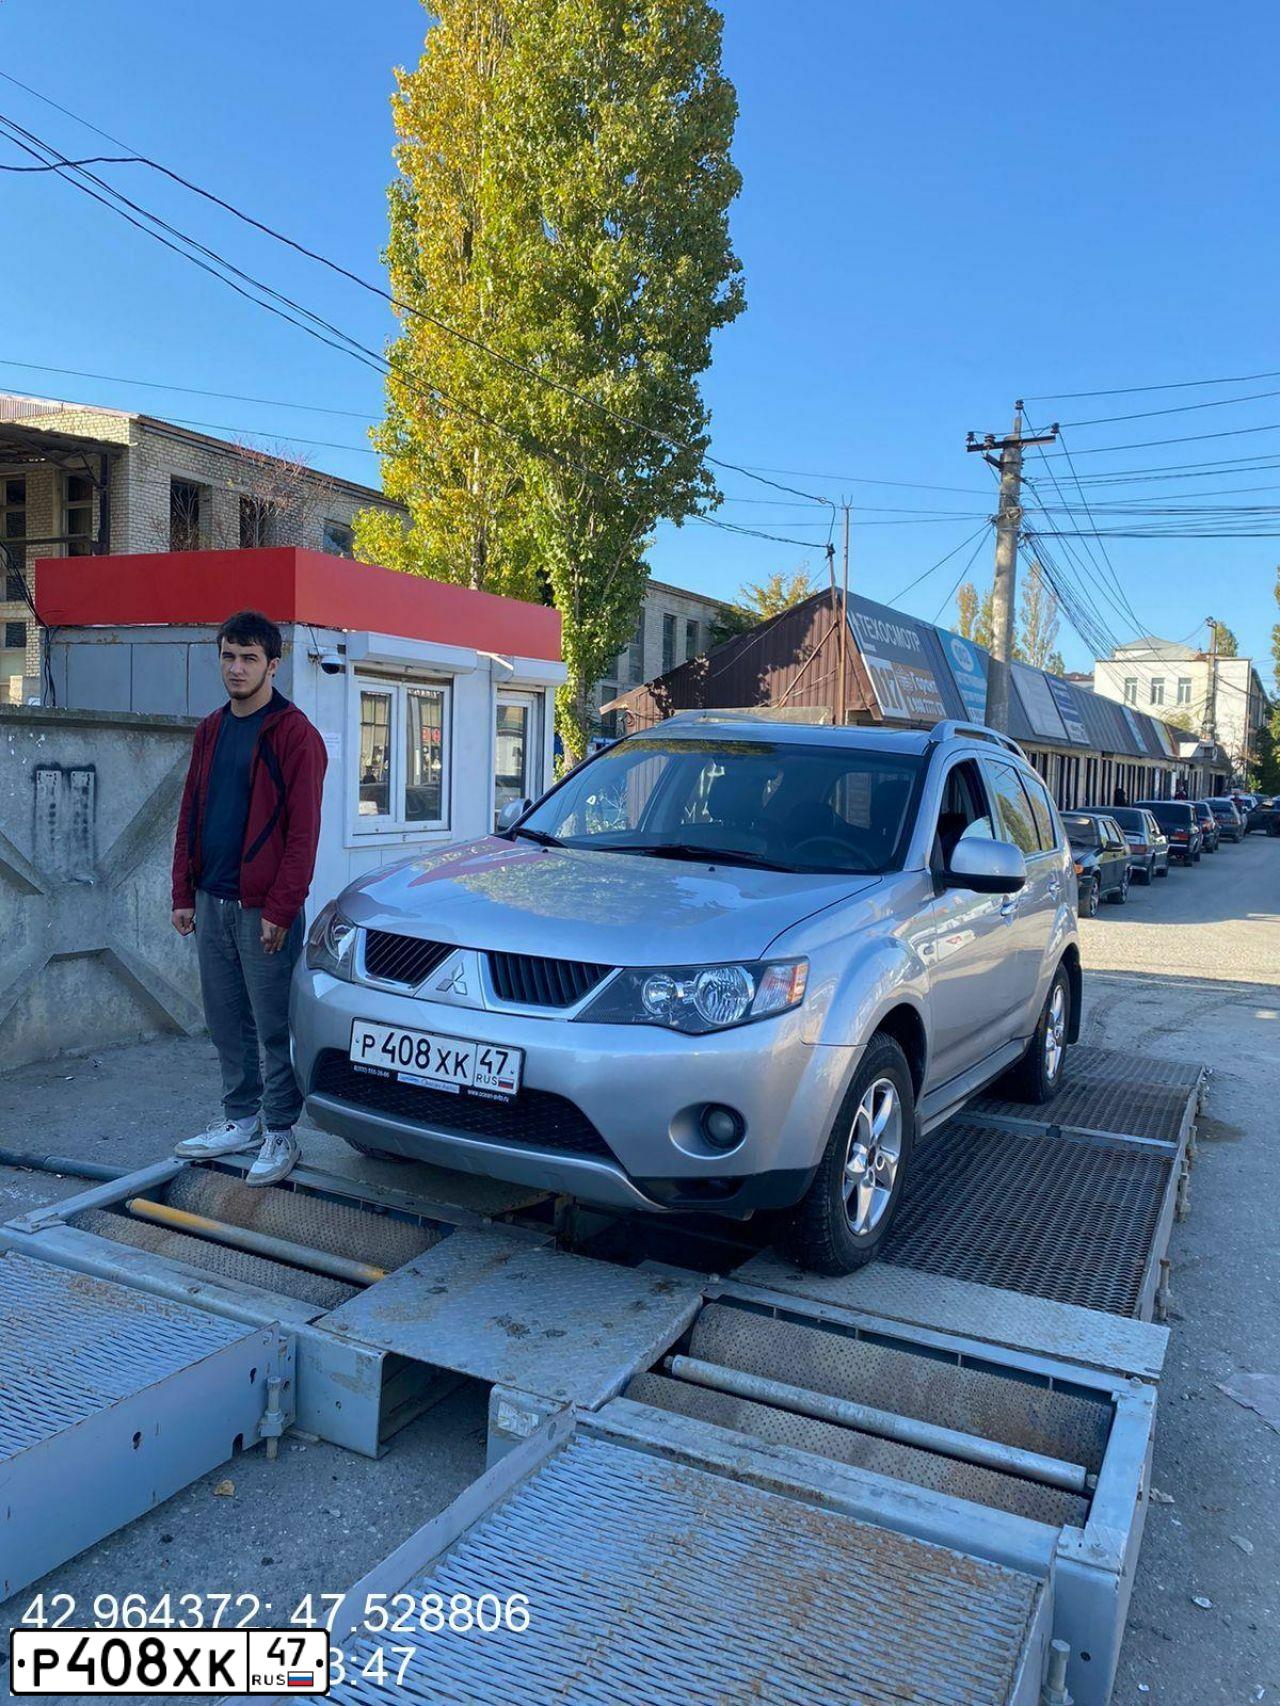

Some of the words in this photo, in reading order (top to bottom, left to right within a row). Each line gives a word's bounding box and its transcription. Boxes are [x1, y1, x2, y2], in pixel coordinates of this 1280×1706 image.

[856, 612, 920, 652] ТЕХОСМОТР
[360, 1031, 470, 1079] Р408ХК
[479, 1048, 509, 1075] 47
[475, 1073, 498, 1086] RUS
